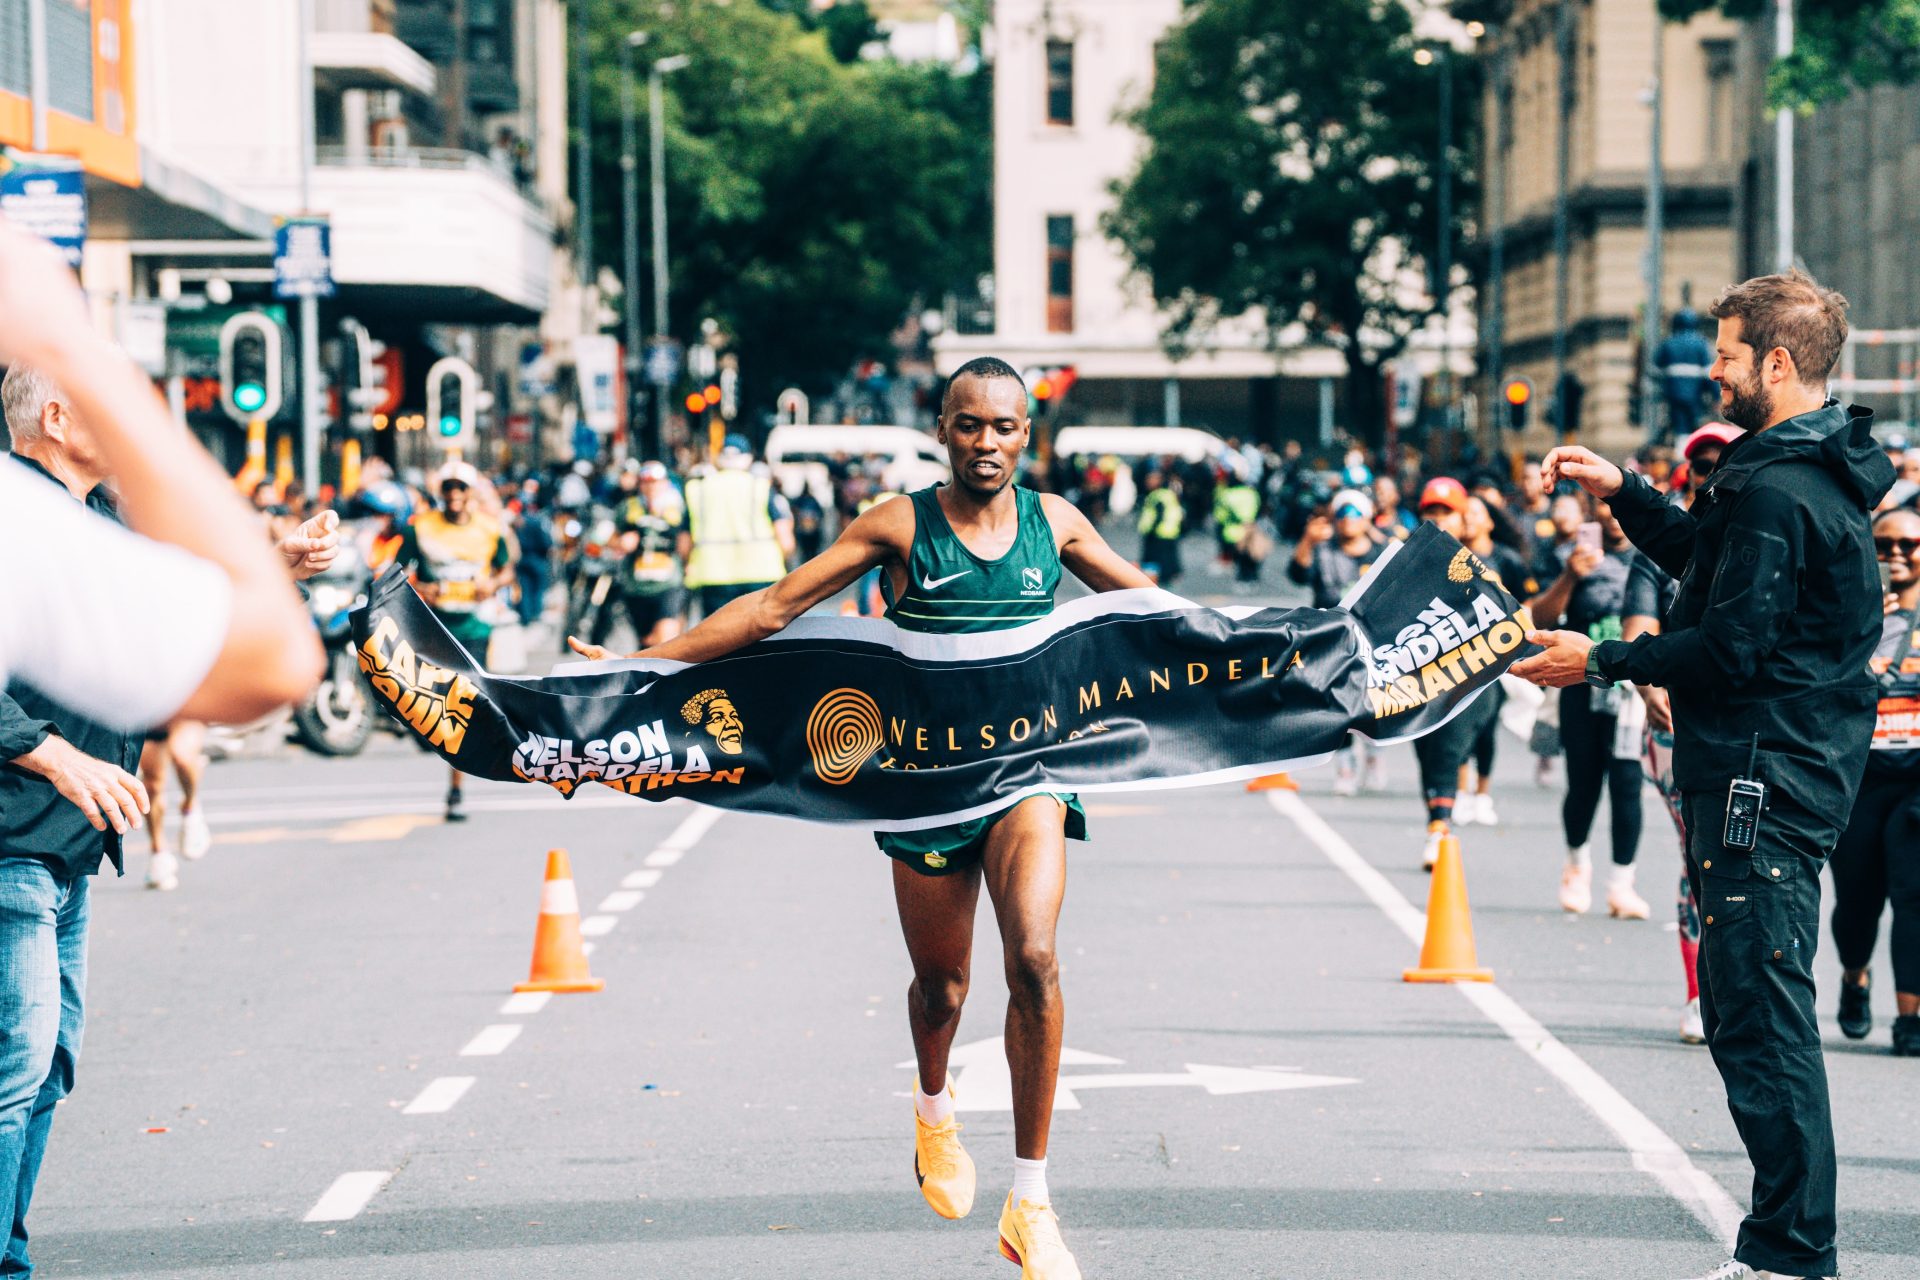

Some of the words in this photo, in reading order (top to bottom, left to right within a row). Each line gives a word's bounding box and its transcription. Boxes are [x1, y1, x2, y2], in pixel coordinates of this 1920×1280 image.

[357, 649, 469, 755] TOWN
[363, 616, 480, 720] CAPE
[891, 705, 1058, 751] NELSON
[1079, 650, 1305, 714] MANDELA
[517, 719, 671, 766] NELSON
